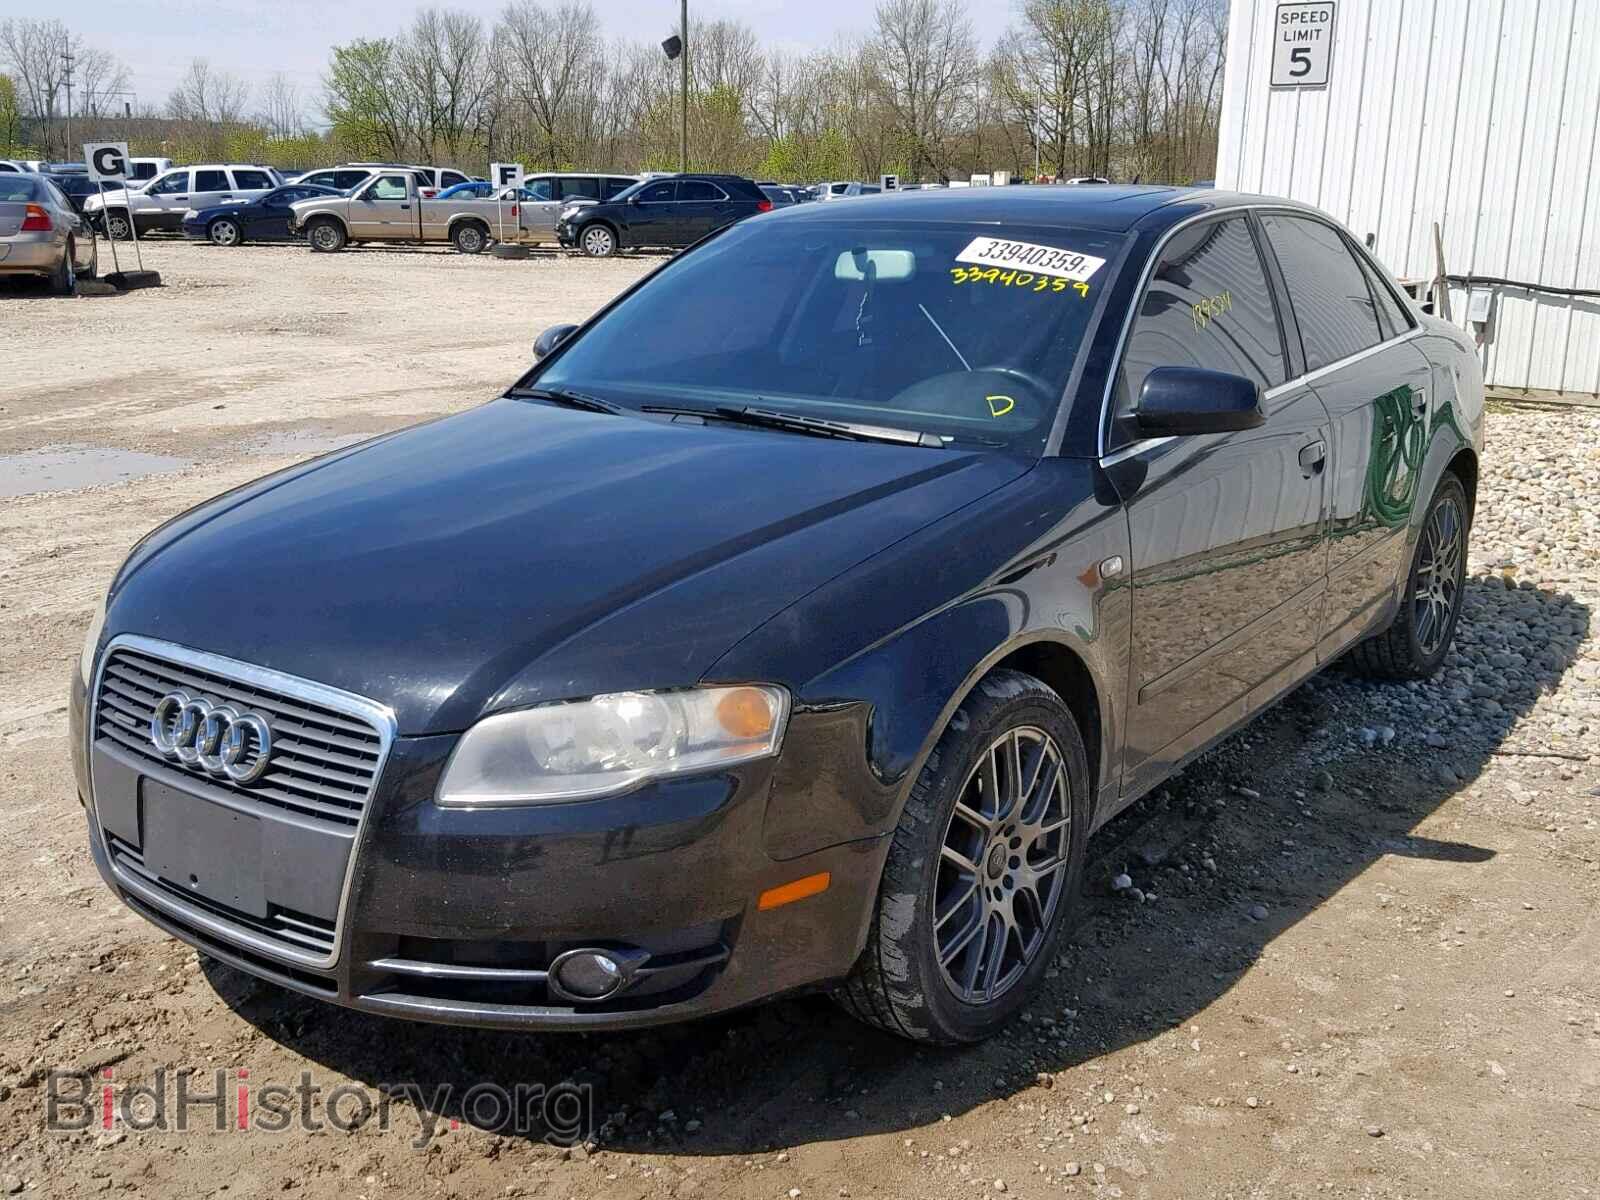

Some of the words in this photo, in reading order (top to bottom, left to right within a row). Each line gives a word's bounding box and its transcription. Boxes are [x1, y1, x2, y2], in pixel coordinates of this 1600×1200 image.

[1281, 11, 1329, 24] SPEED
[1283, 29, 1322, 42] LIMIT
[1289, 47, 1311, 77] 5
[93, 147, 126, 176] G
[500, 167, 517, 185] F
[885, 177, 896, 189] E
[978, 241, 1085, 273] 33940359
[950, 266, 1090, 298] 33940359
[986, 395, 1014, 418] D
